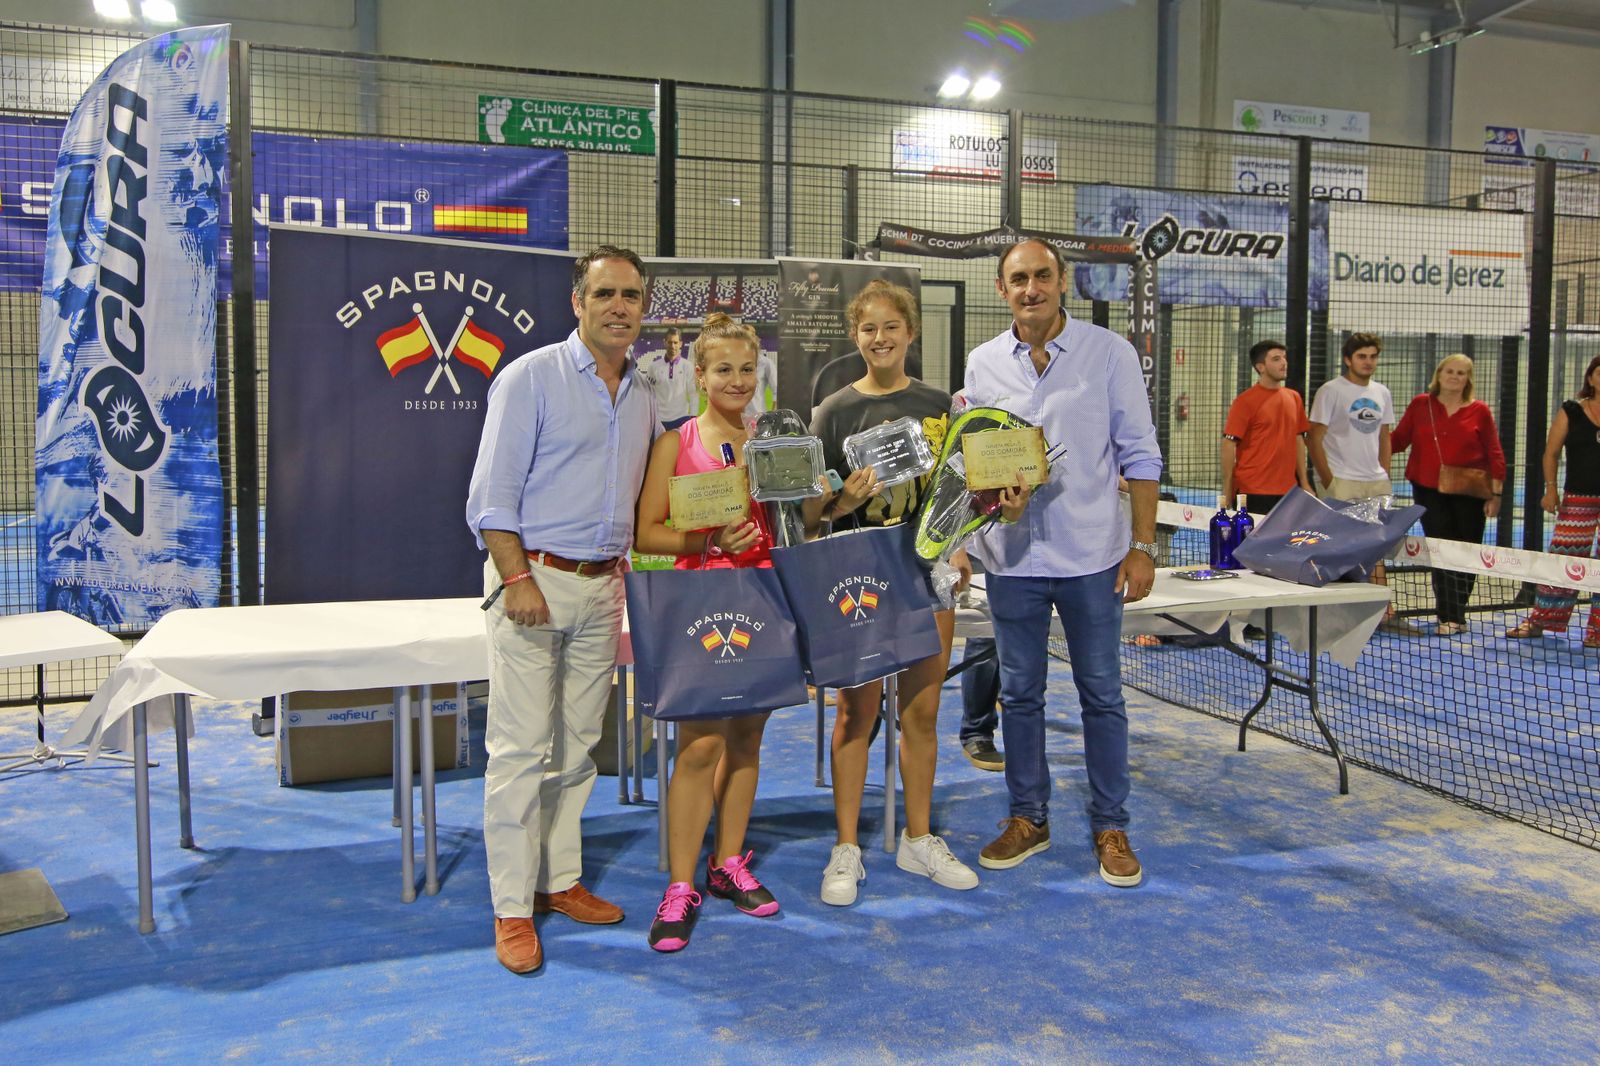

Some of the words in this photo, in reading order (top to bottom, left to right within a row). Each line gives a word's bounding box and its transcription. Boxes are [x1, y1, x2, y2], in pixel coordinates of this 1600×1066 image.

[521, 100, 582, 117] CLÍNICA
[585, 107, 613, 120] DEL
[616, 108, 640, 122] PIE
[520, 117, 642, 140] ATLÁNTICO
[950, 135, 1002, 152] ROTULOS
[985, 153, 1055, 172] LUOSOS
[1334, 251, 1406, 284] Diario
[1411, 254, 1442, 286] de
[1445, 257, 1505, 295] Jerez
[336, 270, 535, 334] SPAGNOLO
[404, 400, 446, 410] DESDE
[452, 400, 478, 410] 1933
[640, 554, 677, 564] SPAG
[828, 575, 888, 603] SPAGNOLO
[686, 612, 763, 637] SPAGNOLO
[326, 709, 379, 722] Jhayber
